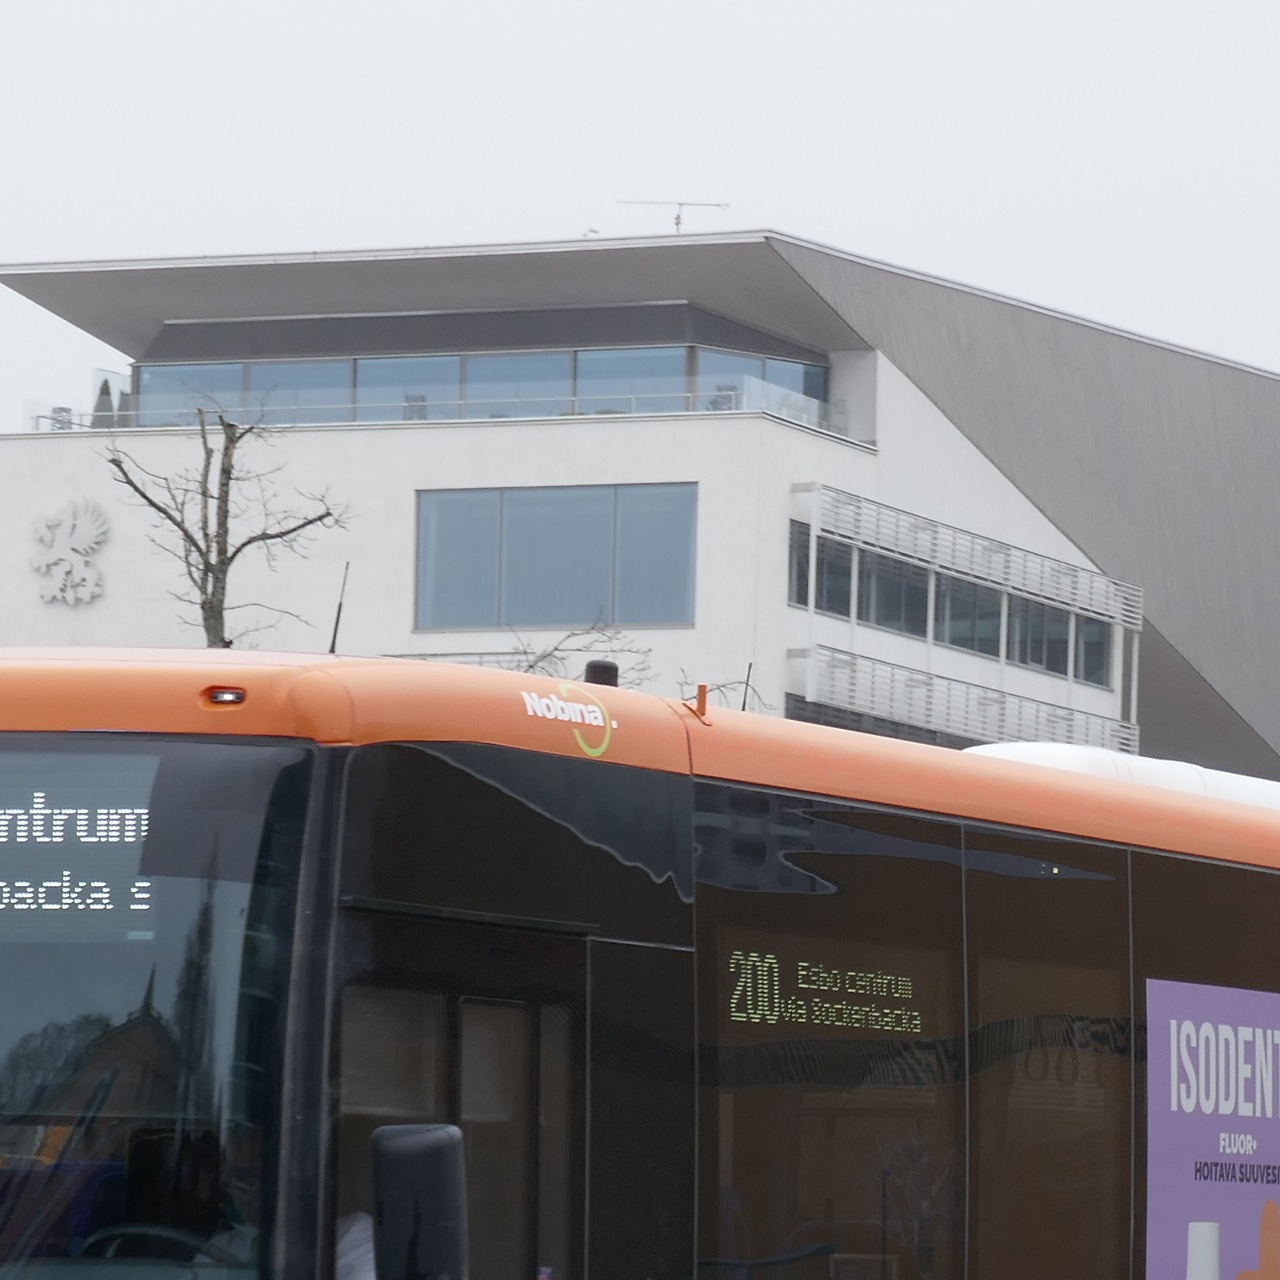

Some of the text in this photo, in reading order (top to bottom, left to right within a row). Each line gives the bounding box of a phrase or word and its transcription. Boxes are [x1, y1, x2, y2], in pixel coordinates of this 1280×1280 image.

[729, 951, 779, 1024] 200
[798, 962, 840, 991] Esbo
[780, 996, 807, 1022] via
[1194, 1161, 1280, 1185] HOITAVA SUUVESI
